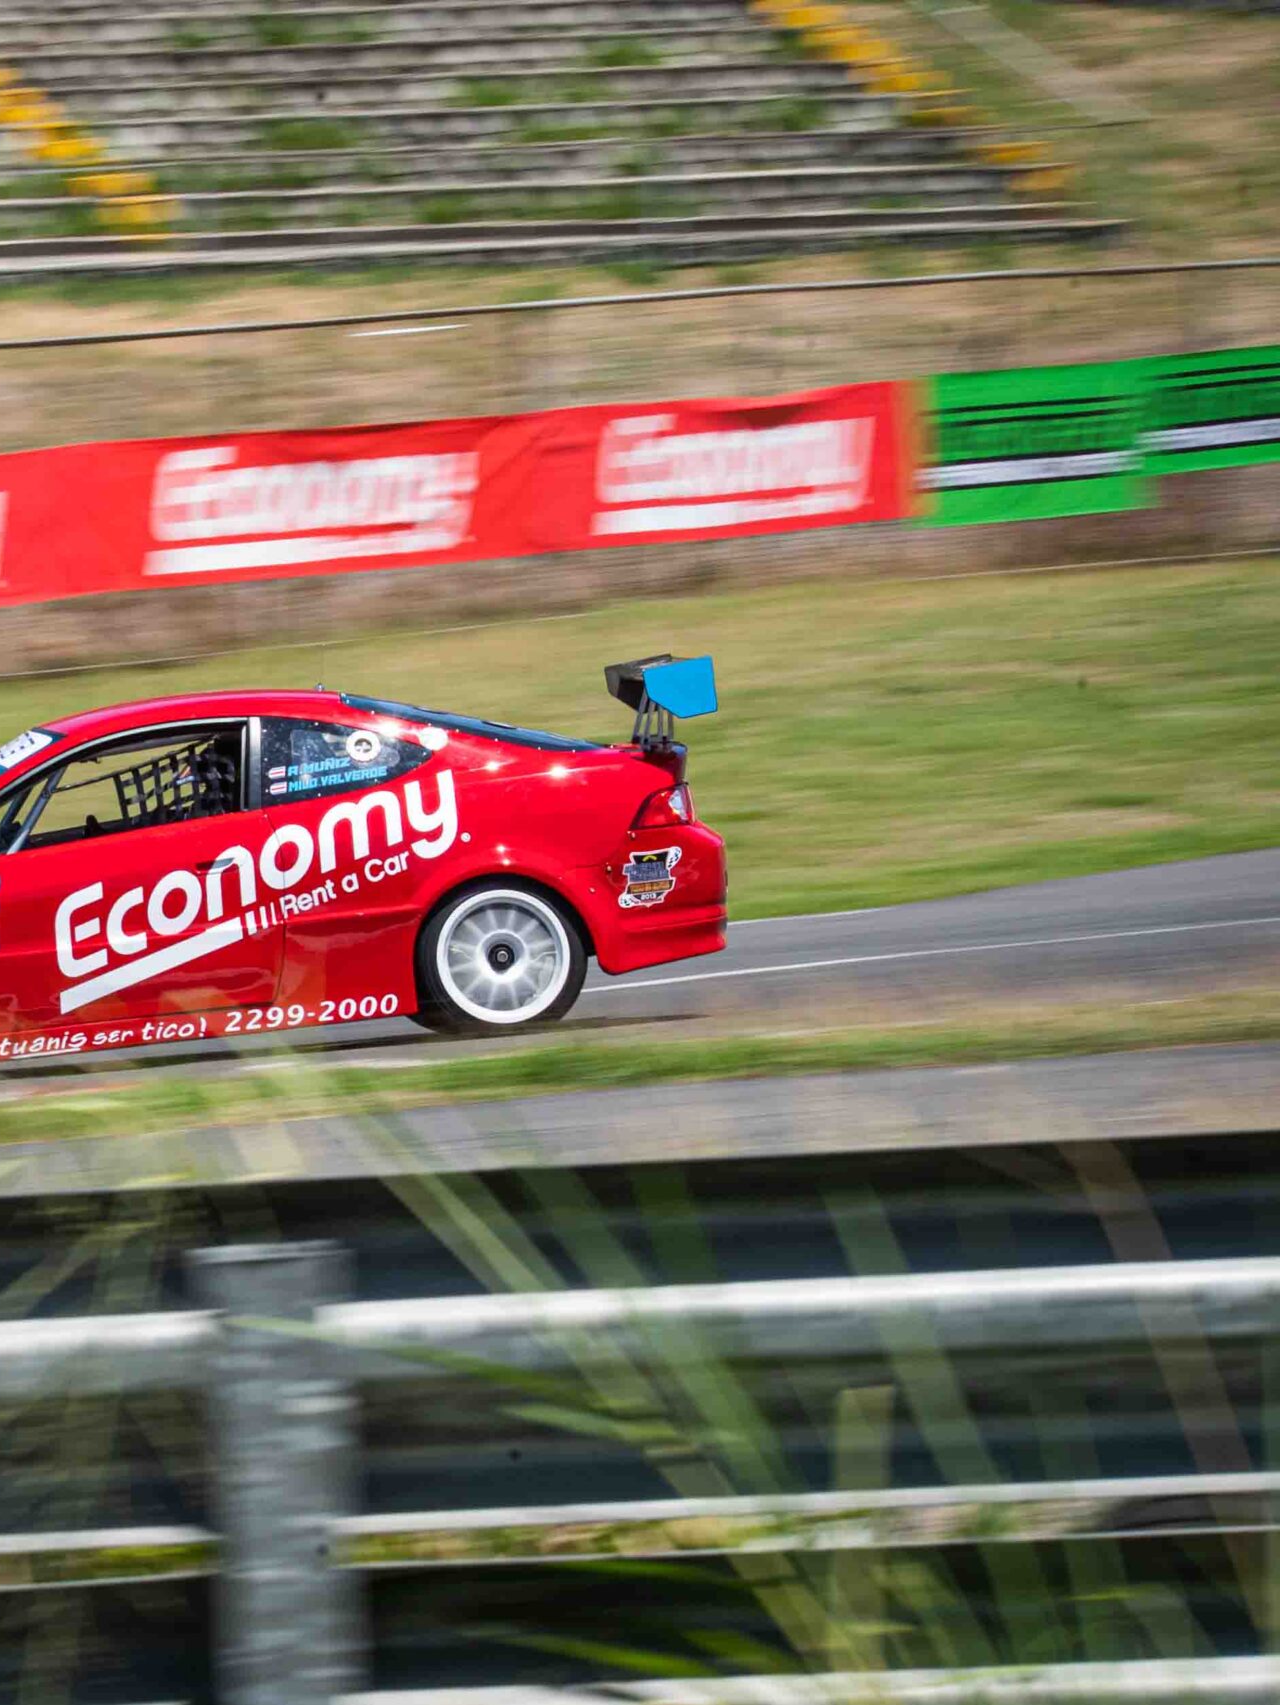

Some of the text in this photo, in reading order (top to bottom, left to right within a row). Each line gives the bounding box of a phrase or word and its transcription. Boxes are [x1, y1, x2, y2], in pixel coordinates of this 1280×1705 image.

[320, 766, 388, 787] VALVERDE
[54, 769, 458, 978] Economy
[279, 850, 410, 920] Rent a Car
[91, 1027, 134, 1048] ser
[141, 1016, 208, 1042] tico!
[224, 993, 400, 1033] 2299-2000
